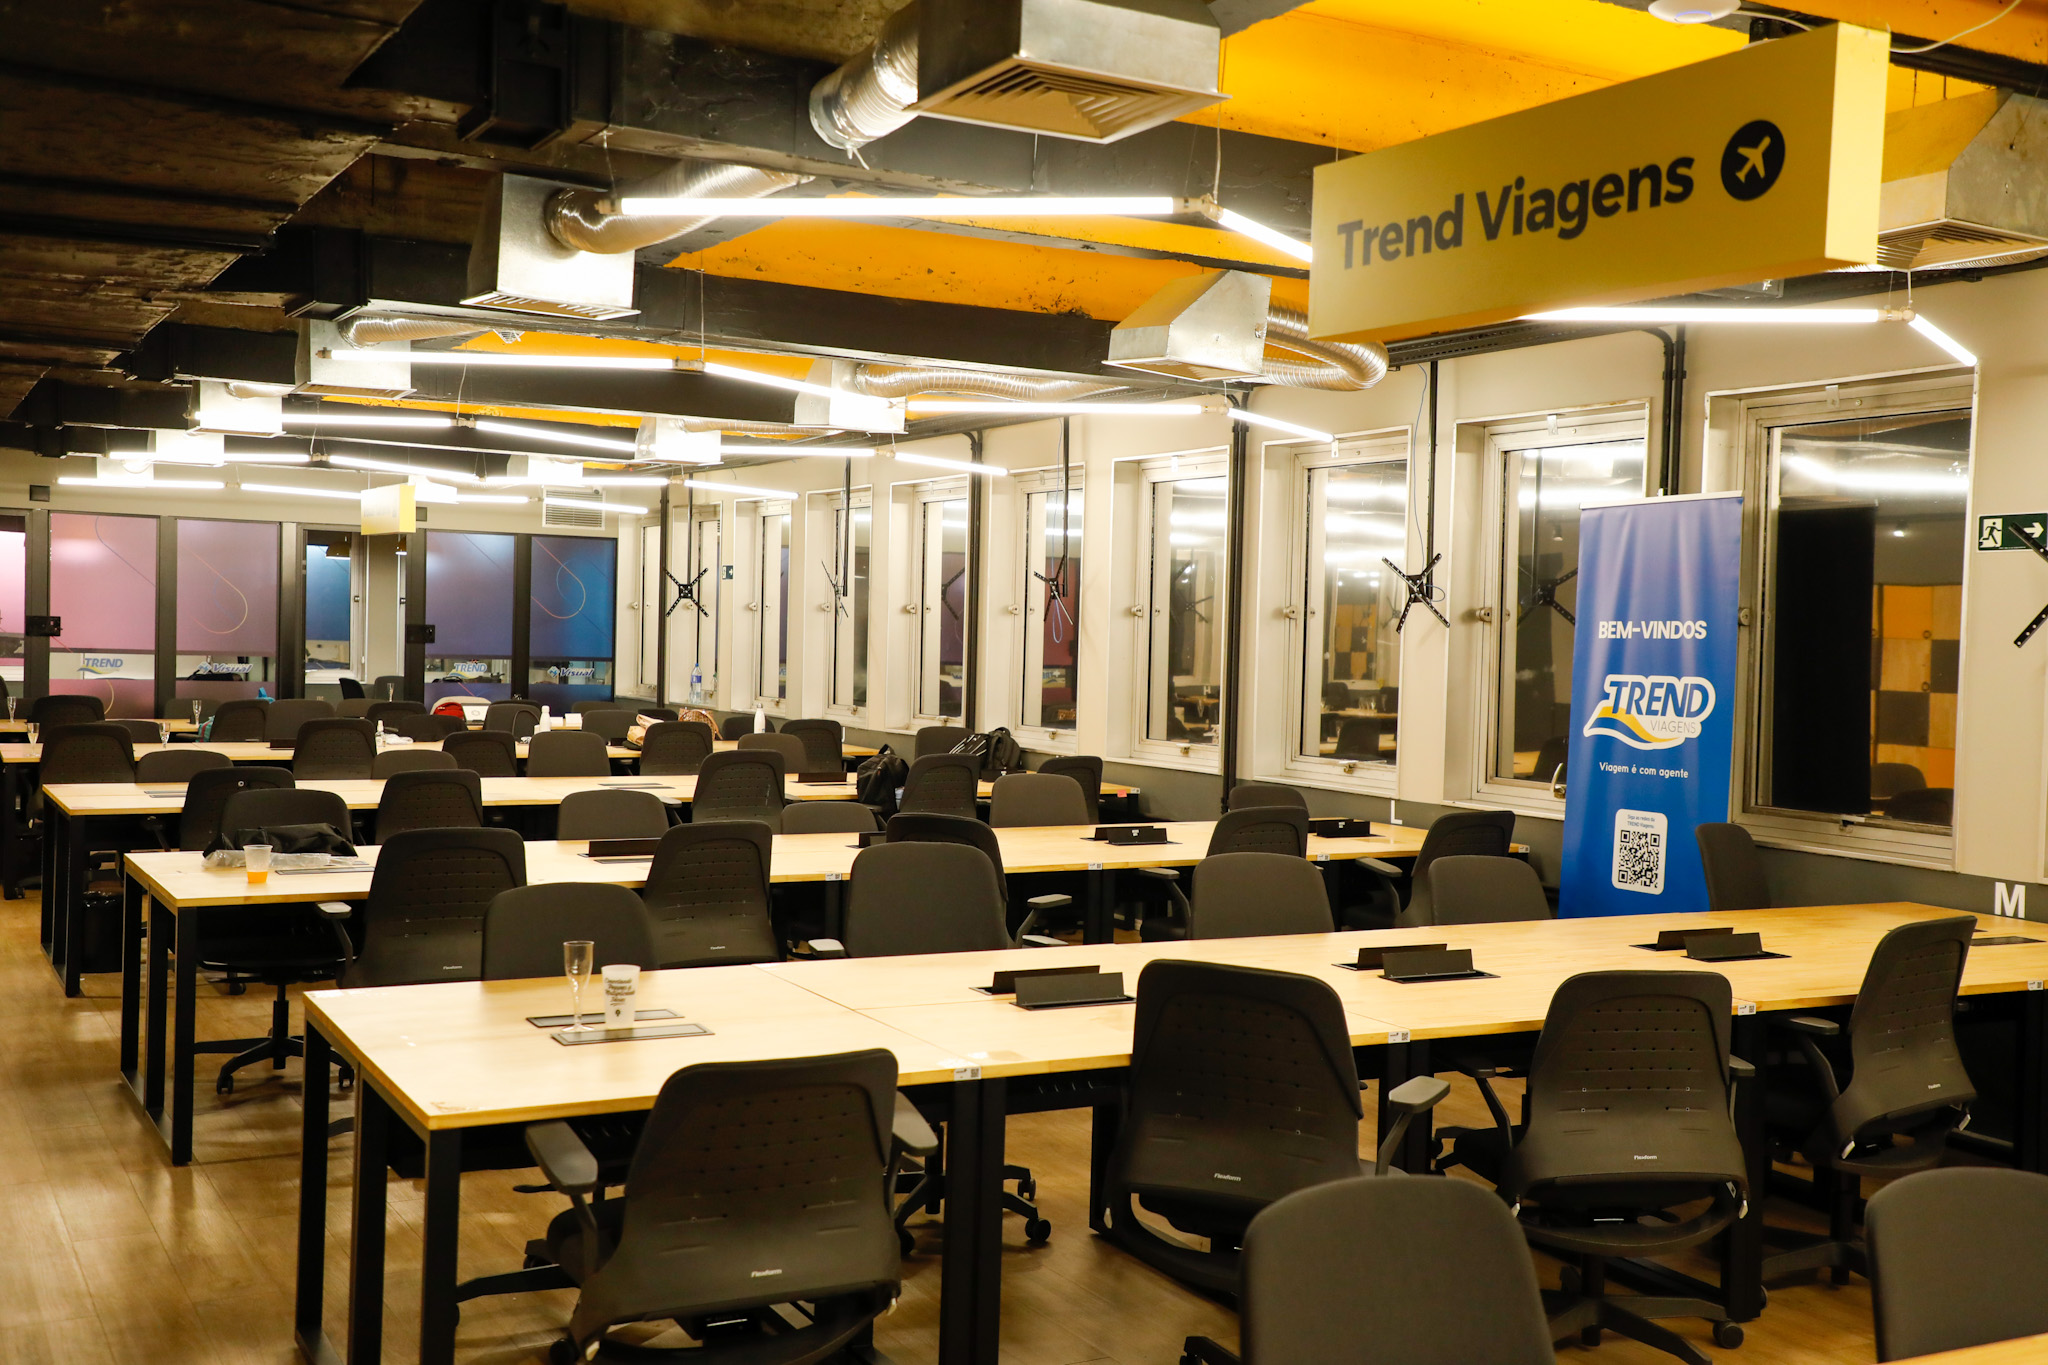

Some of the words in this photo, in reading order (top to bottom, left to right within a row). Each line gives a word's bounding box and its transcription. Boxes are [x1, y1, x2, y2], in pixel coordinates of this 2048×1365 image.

[1338, 193, 1464, 270] Trend
[1475, 156, 1695, 241] Viagens
[1598, 620, 1708, 640] BEM-VINDOS
[85, 658, 123, 668] TREND
[212, 663, 253, 673] Visual
[455, 663, 488, 673] TREND
[561, 667, 594, 677] Visual
[1609, 680, 1710, 719] TREND
[1650, 719, 1696, 734] VIAGENS
[1599, 761, 1629, 775] Viagem
[1631, 764, 1637, 774] é
[1639, 766, 1657, 776] com
[1659, 767, 1689, 779] agente
[1390, 799, 1403, 825] L
[1994, 881, 2026, 919] M
